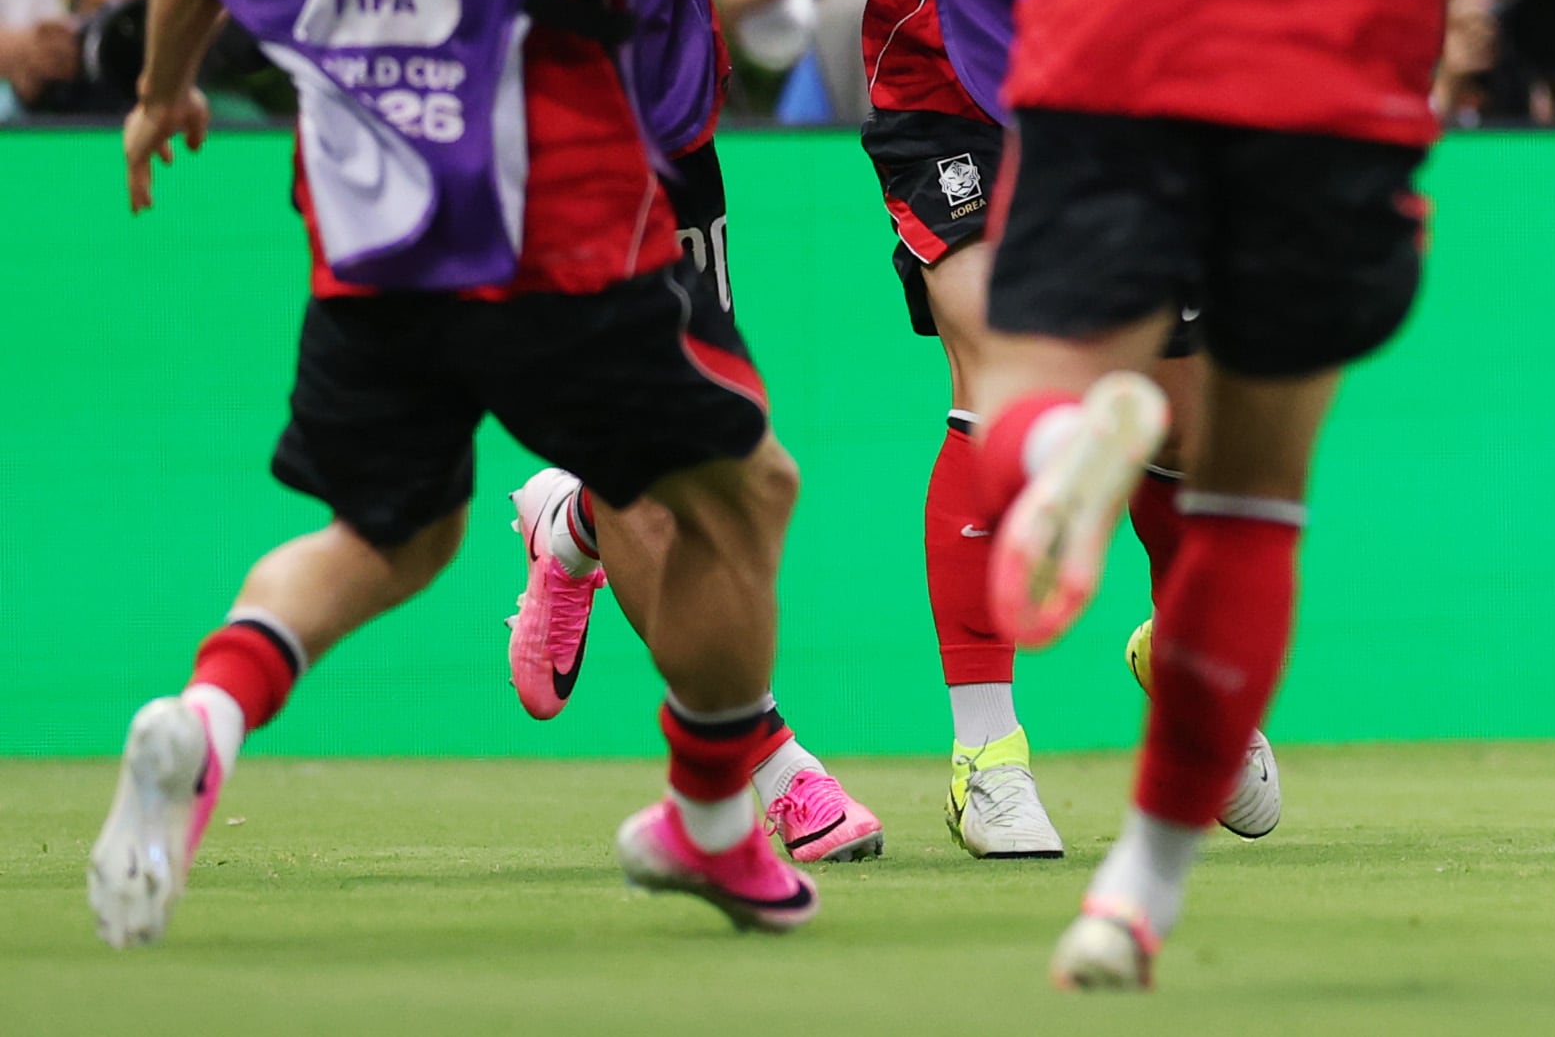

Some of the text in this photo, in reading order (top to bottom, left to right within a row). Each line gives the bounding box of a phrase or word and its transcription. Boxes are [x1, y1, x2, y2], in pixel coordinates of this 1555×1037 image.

[404, 55, 467, 91] CUP
[360, 88, 466, 144] 26
[949, 197, 988, 221] KOREA
